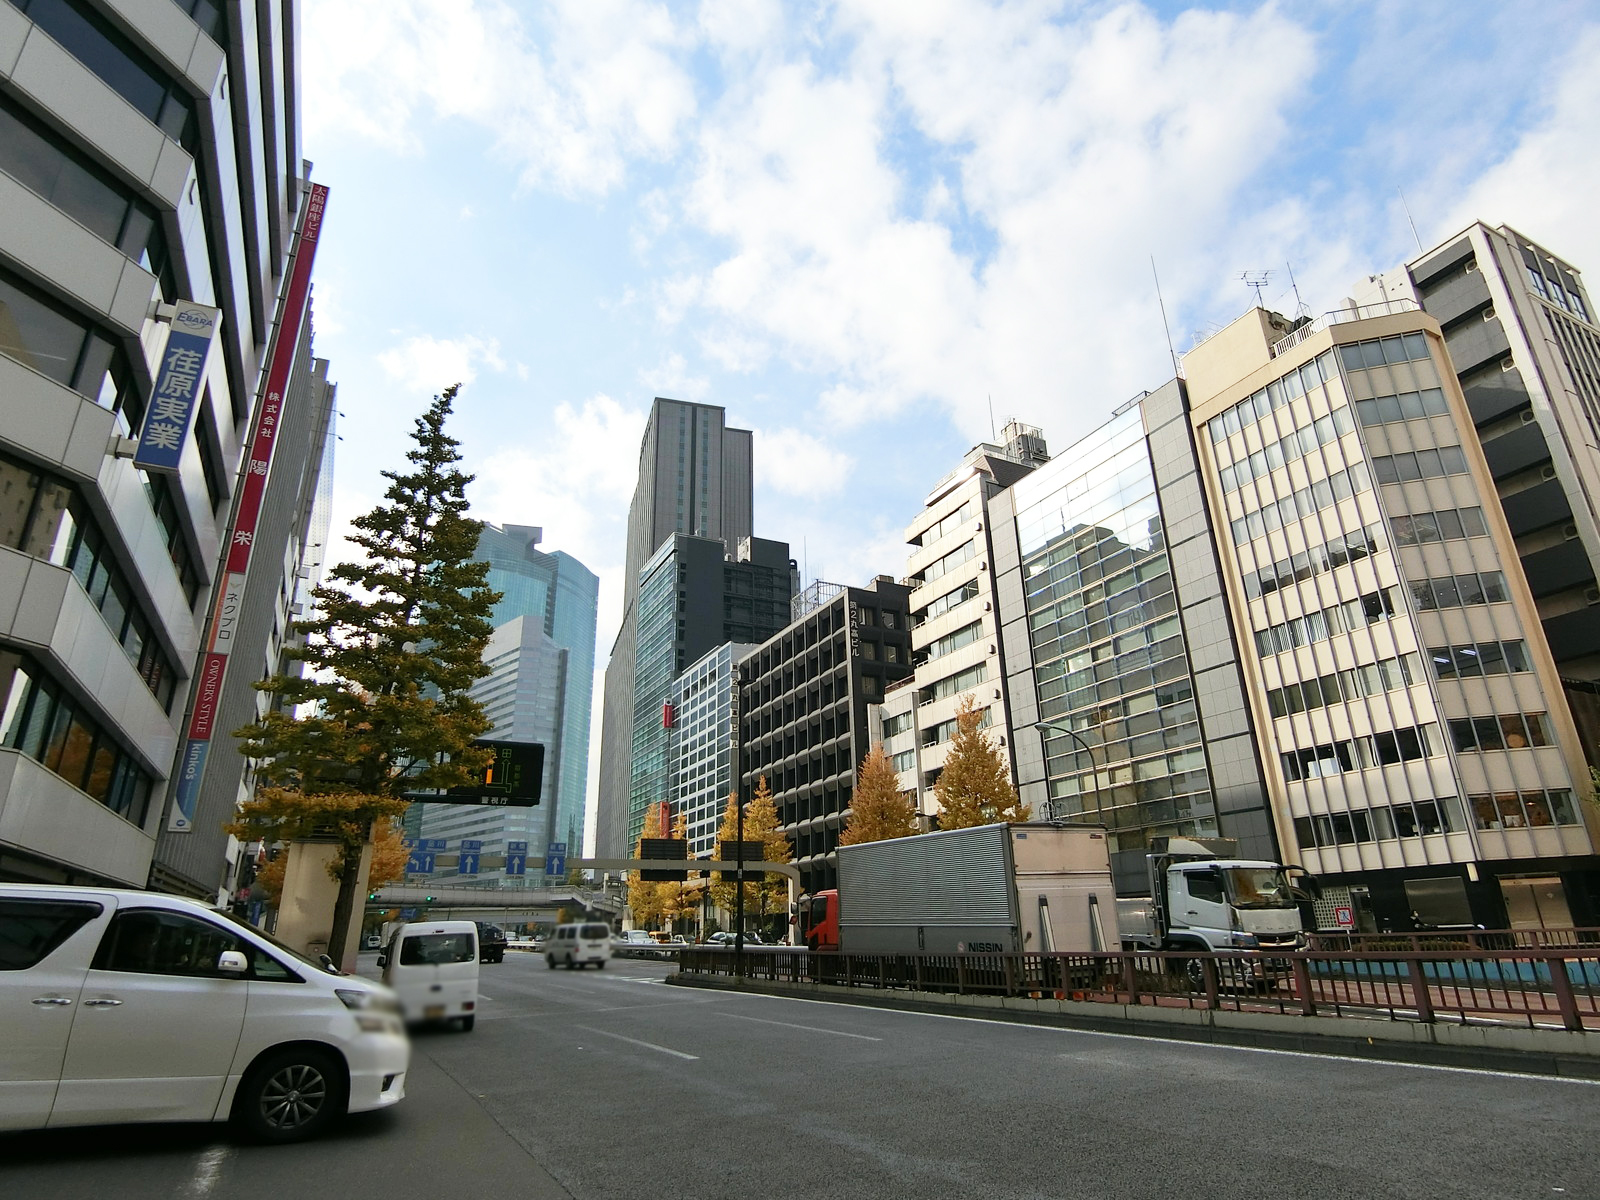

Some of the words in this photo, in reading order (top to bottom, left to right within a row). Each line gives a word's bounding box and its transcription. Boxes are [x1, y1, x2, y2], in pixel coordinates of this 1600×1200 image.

[305, 186, 326, 238] 太陽銀座ビル
[176, 312, 212, 326] EBARA
[145, 347, 203, 451] 荏原実業
[219, 593, 238, 639] ネクプロ
[195, 704, 211, 733] STYLE
[185, 743, 203, 780] kinko's
[968, 943, 1003, 953] NISSIN
